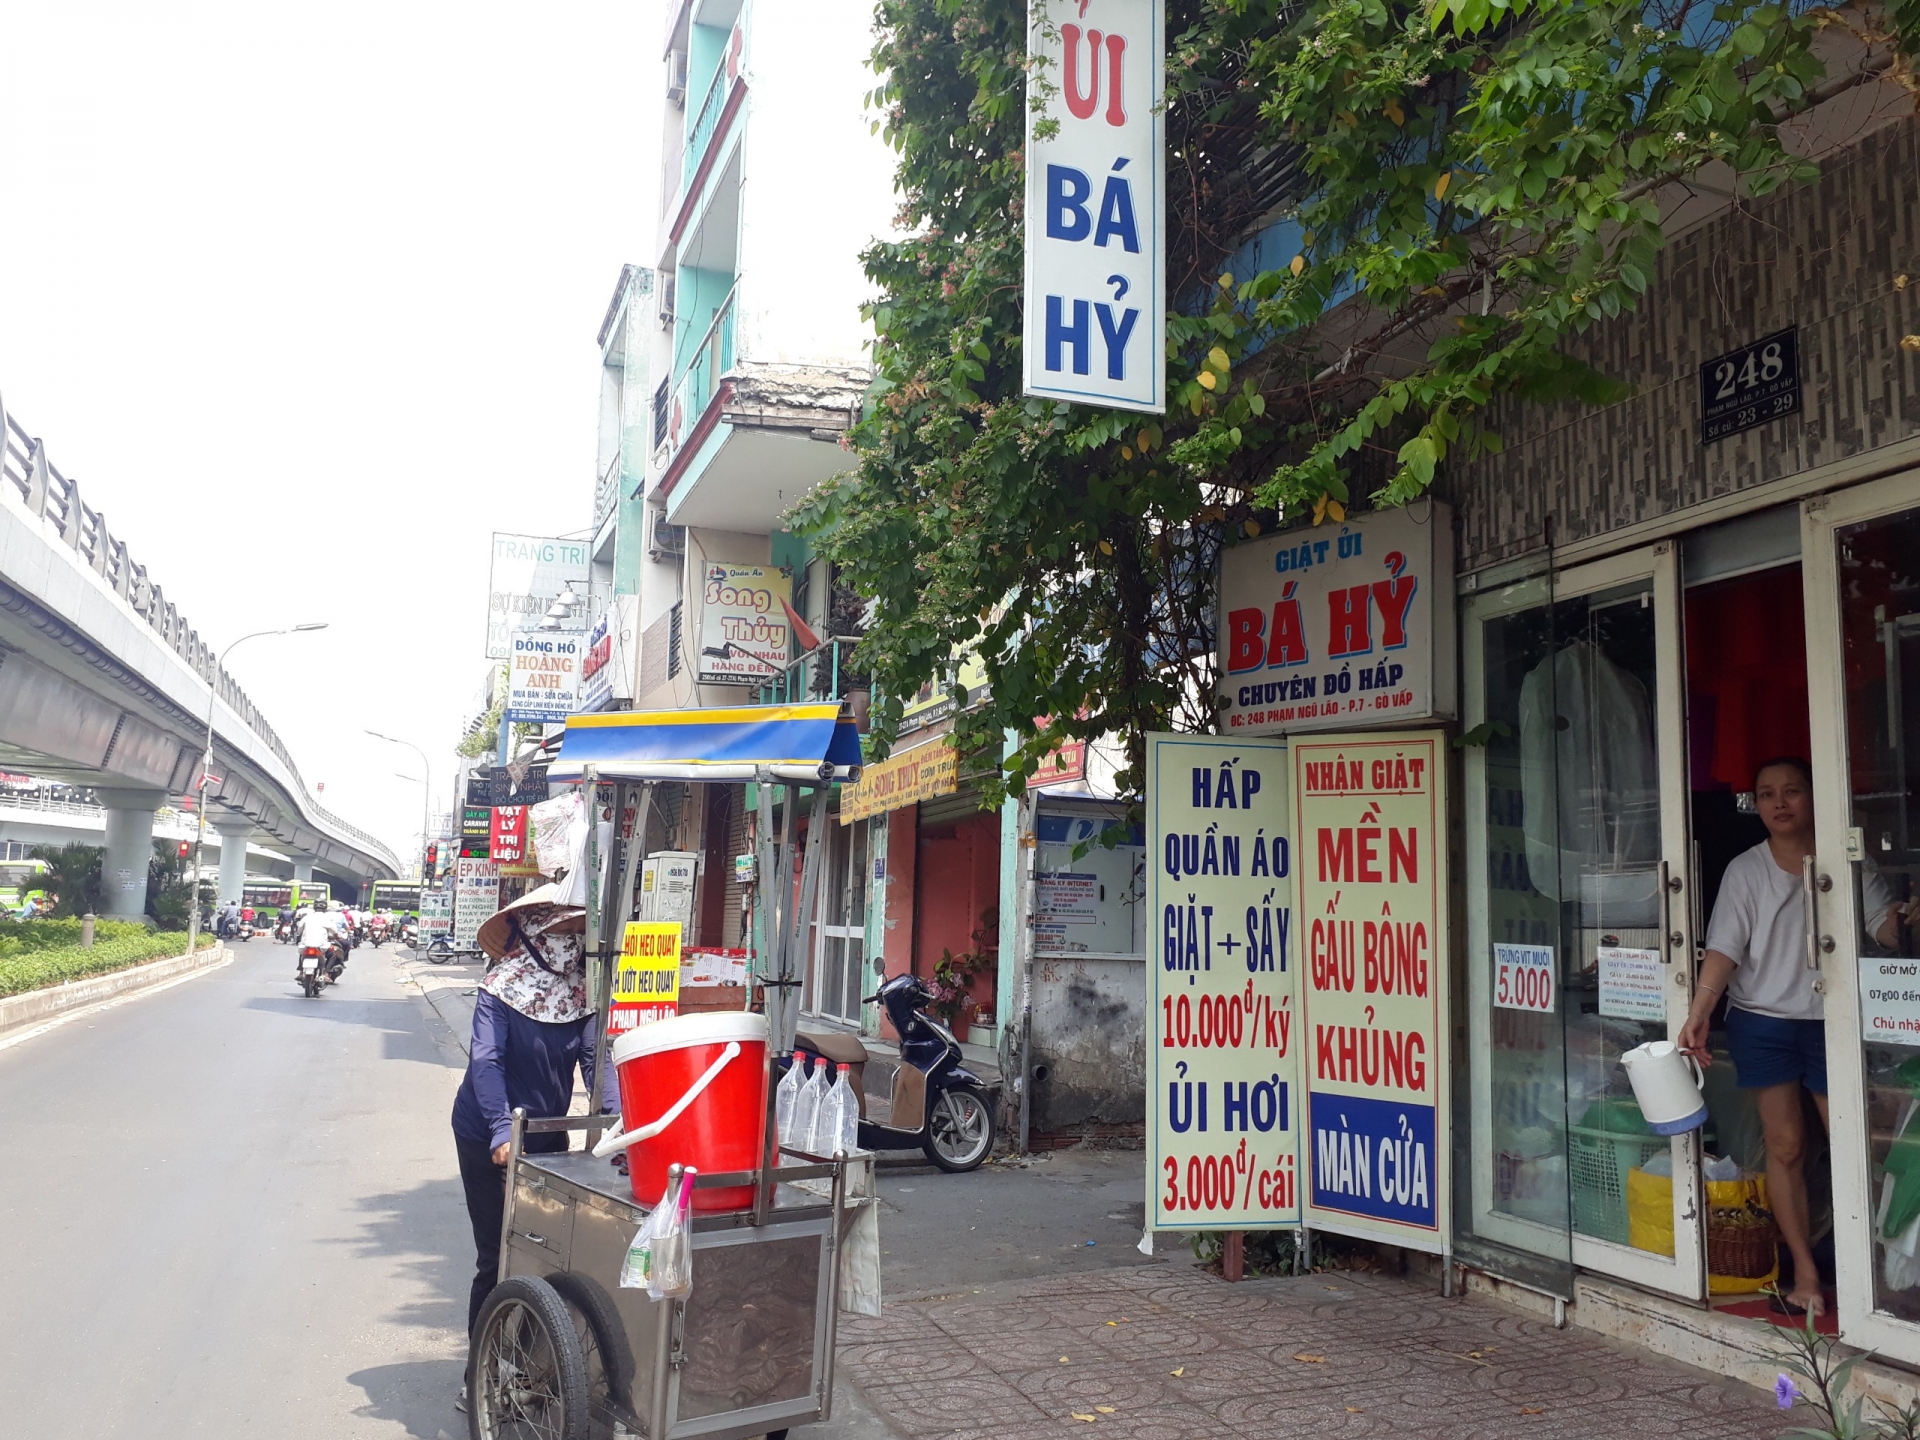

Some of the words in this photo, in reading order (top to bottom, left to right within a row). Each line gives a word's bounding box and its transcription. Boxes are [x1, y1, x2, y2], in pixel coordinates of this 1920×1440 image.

[1046, 157, 1142, 254] BÁ
[1045, 273, 1142, 381] HỶ
[1715, 342, 1783, 400] 248
[1738, 407, 1756, 427] 23
[1773, 393, 1793, 413] 29
[496, 540, 554, 562] TRANG
[560, 544, 586, 565] TRÍ
[1275, 540, 1329, 573] GIẶT
[1338, 526, 1362, 559] ỦI
[706, 580, 771, 613] Song
[1228, 580, 1308, 676] BÁ
[1328, 551, 1418, 659] HỶ
[515, 636, 553, 652] ĐỒNG
[557, 639, 576, 654] HỒ
[721, 616, 785, 649] Thủy
[516, 653, 573, 672] HOÀNG
[712, 661, 744, 671] HÀNG
[748, 663, 775, 673] ĐÊM
[526, 673, 562, 689] ANH
[1238, 674, 1316, 707] CHUYÊN
[1324, 661, 1351, 696] ĐỒ
[1359, 656, 1403, 691] HẤP
[1231, 713, 1245, 728] ĐC:
[1247, 711, 1264, 726] 248
[1267, 706, 1295, 724] PHẠM
[1298, 701, 1317, 720] NGŨ
[1321, 700, 1338, 715] LÃO
[1349, 699, 1364, 713] P.7
[1376, 694, 1390, 710] GÒ
[1392, 691, 1413, 708] VẤP
[533, 768, 545, 779] TRÍ
[874, 770, 895, 798] SONG
[897, 753, 920, 791] THỦY
[1192, 757, 1261, 809] HẤP
[1305, 753, 1364, 797] NHẬN
[1371, 752, 1425, 796] GIẶT
[495, 795, 507, 804] ĐỒ
[498, 835, 518, 846] TRỊ
[501, 818, 516, 830] LÝ
[493, 848, 520, 861] LIỆU
[1165, 822, 1240, 881] QUẦN
[1251, 828, 1289, 878] ÁO
[1318, 802, 1418, 883] MỀN
[460, 859, 473, 877] ÉP
[475, 859, 498, 877] KÍNH
[640, 934, 655, 956] HEO
[657, 934, 676, 959] QUAY
[1164, 893, 1213, 985] GIẶT
[1246, 887, 1290, 973] SẤY
[1310, 890, 1354, 993] GẤU
[1363, 901, 1427, 998] BÔNG
[1497, 946, 1520, 964] TRỨNG
[1520, 950, 1530, 968] VỊT
[1880, 963, 1897, 975] GIỜ
[1900, 963, 1917, 975] MỞ
[622, 966, 637, 993] ƯỚT
[639, 970, 654, 993] HEO
[656, 970, 675, 995] QUAY
[1497, 965, 1550, 1009] 5.000
[1869, 989, 1899, 1002] 07g00
[1873, 1016, 1895, 1029] Chủ
[1316, 1005, 1426, 1092] KHỦNG
[1169, 1060, 1207, 1133] ỦI
[1223, 1073, 1288, 1132] HƠI
[1318, 1114, 1370, 1198] MÀN
[1378, 1113, 1429, 1208] CỬA
